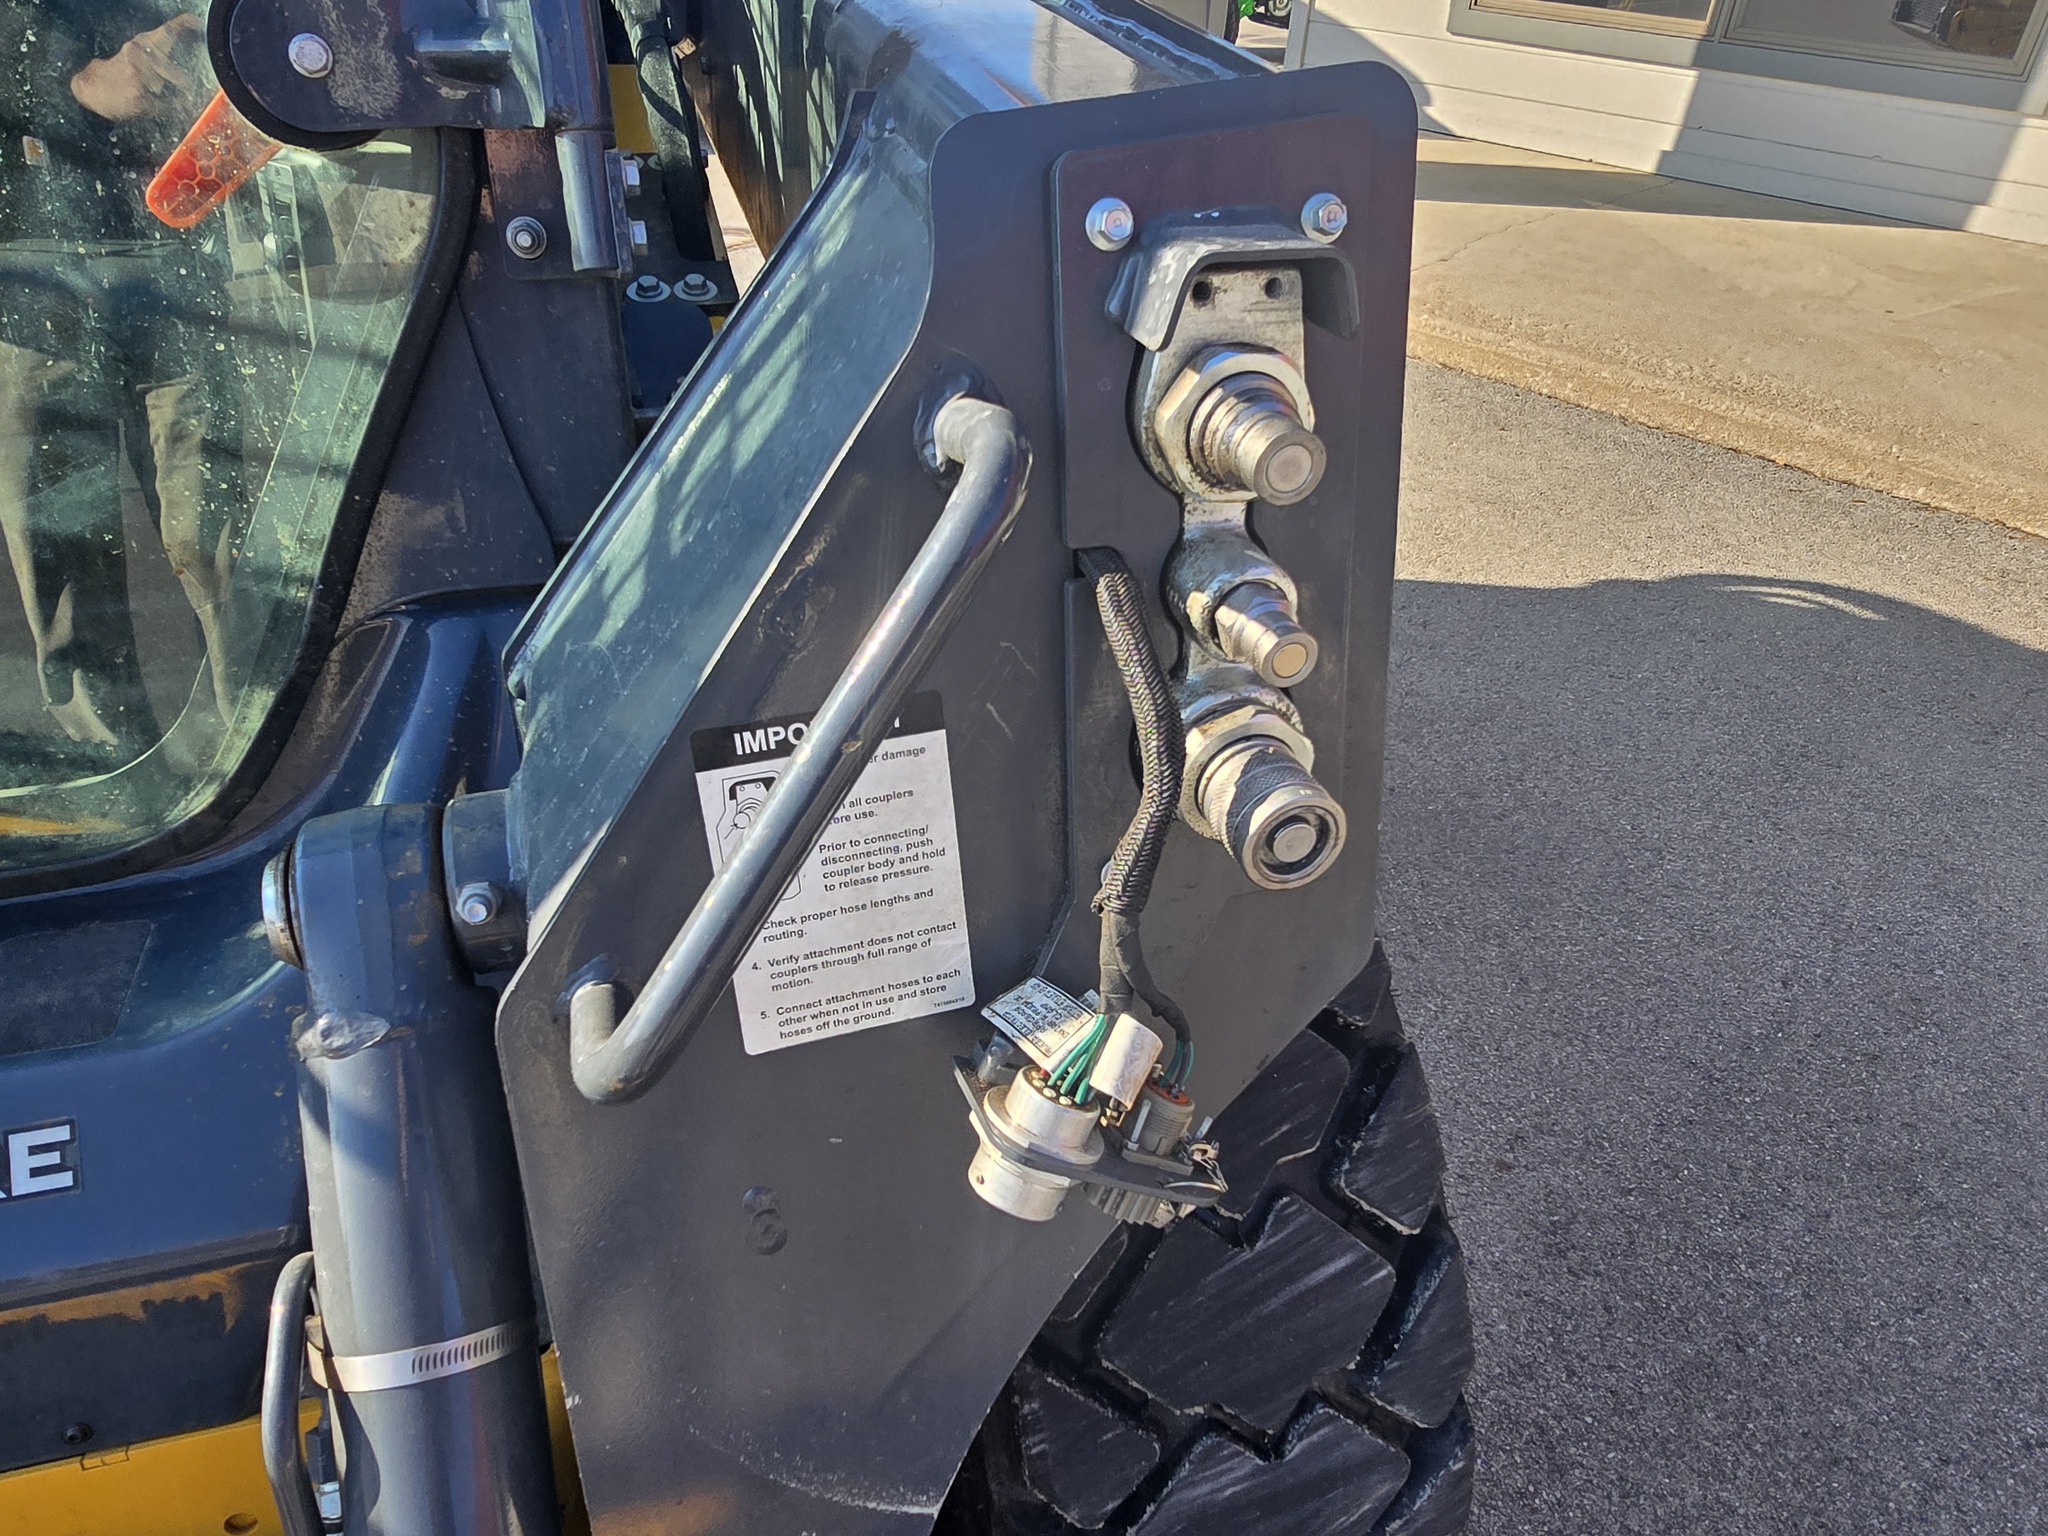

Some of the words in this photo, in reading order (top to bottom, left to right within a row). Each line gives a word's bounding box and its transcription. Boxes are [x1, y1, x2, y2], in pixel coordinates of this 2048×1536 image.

[882, 746, 926, 761] damage
[849, 797, 862, 809] all
[865, 790, 914, 805] couplers
[854, 810, 878, 820] use.
[819, 843, 846, 853] Prior
[849, 840, 861, 848] to
[864, 824, 929, 845] connecting/
[906, 838, 933, 852] push
[823, 864, 866, 879] coupler
[868, 858, 896, 870] body
[899, 852, 919, 864] and
[922, 847, 946, 860] hold
[824, 884, 836, 892] to
[839, 876, 879, 889] release
[882, 865, 933, 882] pressure.
[800, 909, 838, 925] proper
[840, 903, 868, 915] hose
[870, 894, 911, 909] lengths
[913, 888, 934, 900] and
[751, 962, 762, 971] 4.
[767, 954, 800, 968] Verify
[803, 940, 865, 961] attachment
[867, 934, 894, 947] does
[896, 930, 914, 941] not
[917, 921, 957, 936] contact
[763, 929, 807, 943] routing.
[770, 964, 819, 980] couplers
[821, 953, 865, 970] through
[867, 949, 885, 960] full
[887, 941, 918, 955] range
[920, 938, 933, 948] of
[760, 1010, 770, 1020] 5.
[776, 999, 823, 1017] Connect
[825, 985, 886, 1005] attachment
[888, 979, 920, 992] hoses
[923, 975, 933, 984] to
[936, 968, 961, 982] each
[771, 976, 814, 993] motion.
[778, 1014, 808, 1028] other
[810, 1008, 839, 1021] when
[842, 1003, 860, 1014] not
[862, 1000, 873, 1010] in
[875, 997, 895, 1006] use
[897, 989, 917, 1001] and
[920, 984, 947, 996] store
[779, 1025, 813, 1040] hoses
[816, 1019, 831, 1032] off
[833, 1018, 850, 1028] the
[853, 1007, 894, 1025] ground.
[0, 1125, 74, 1197] E
